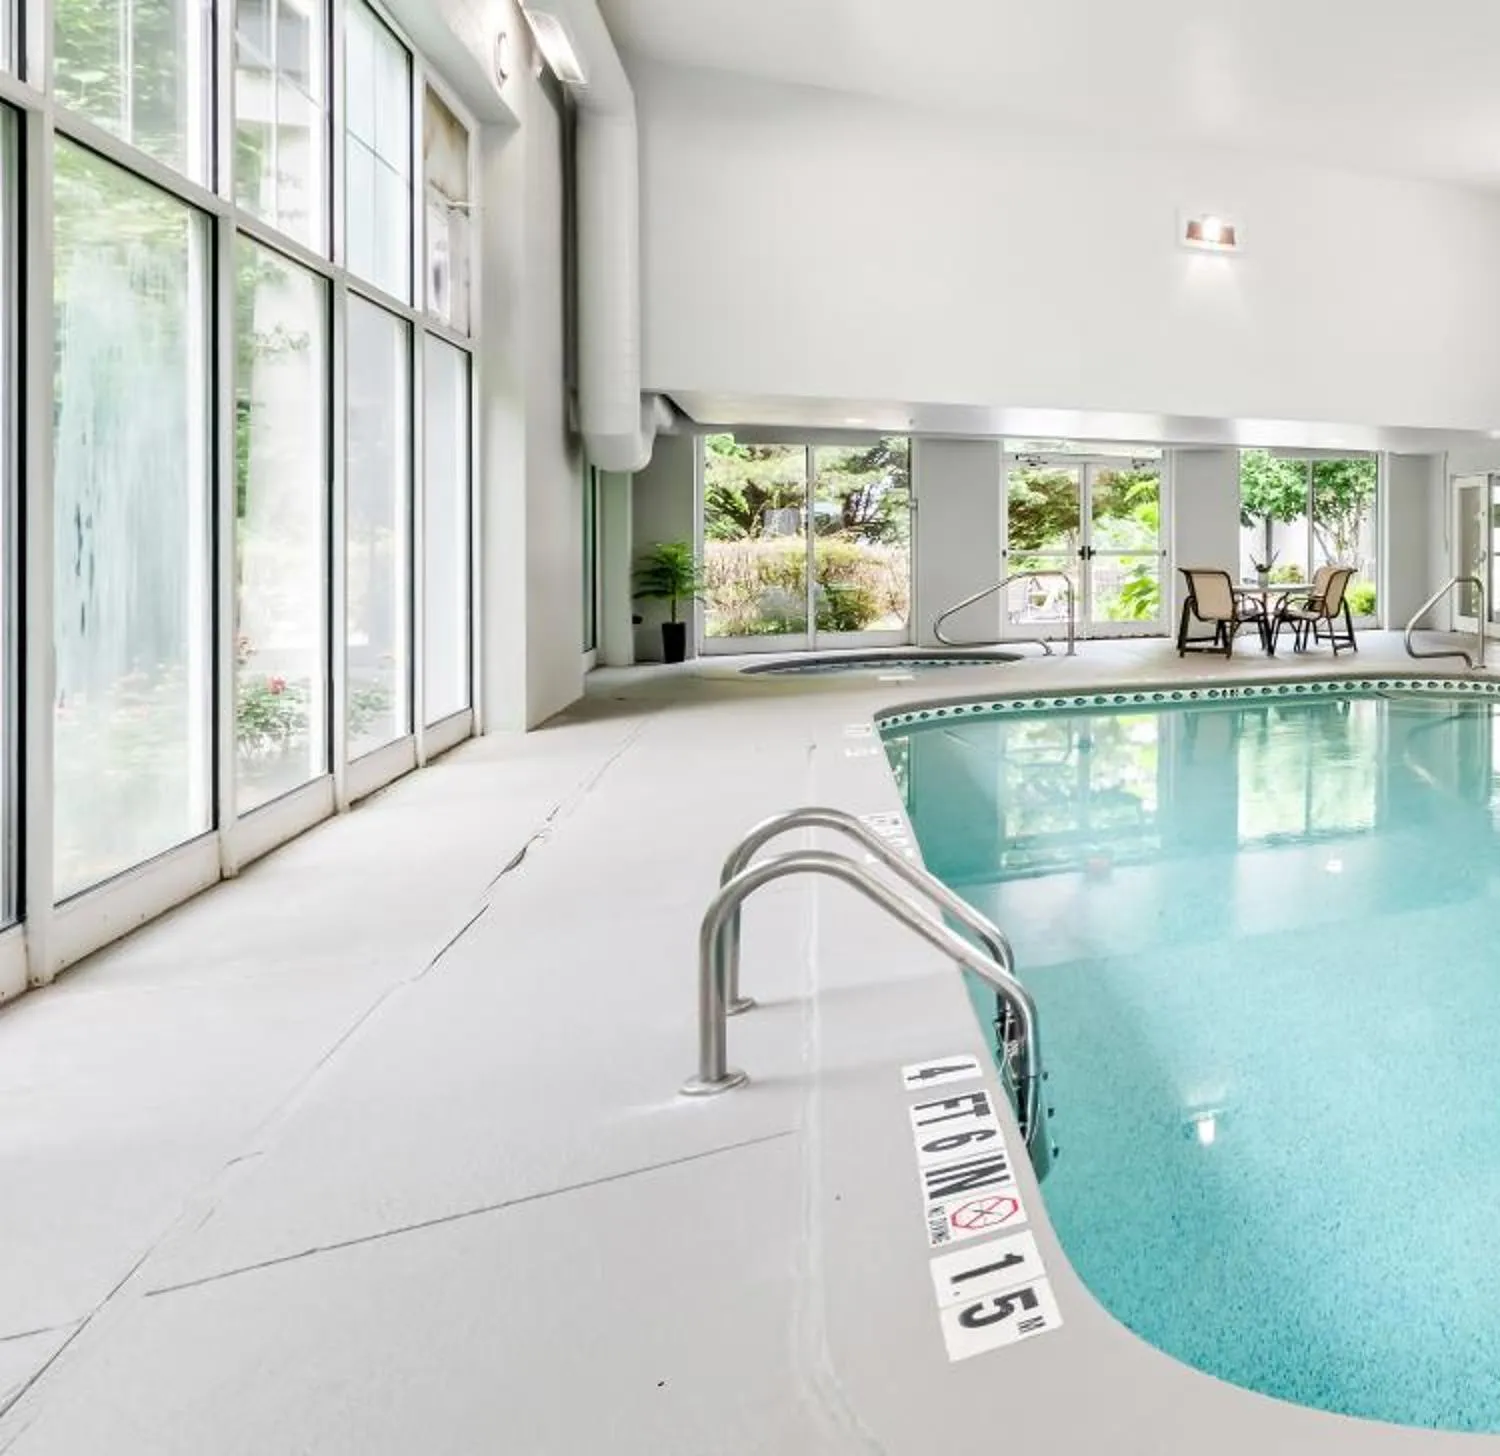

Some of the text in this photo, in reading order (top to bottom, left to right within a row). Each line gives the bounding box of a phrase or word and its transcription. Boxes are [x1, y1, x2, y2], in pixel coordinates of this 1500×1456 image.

[906, 1062, 1011, 1201] 4 FT 6 IN
